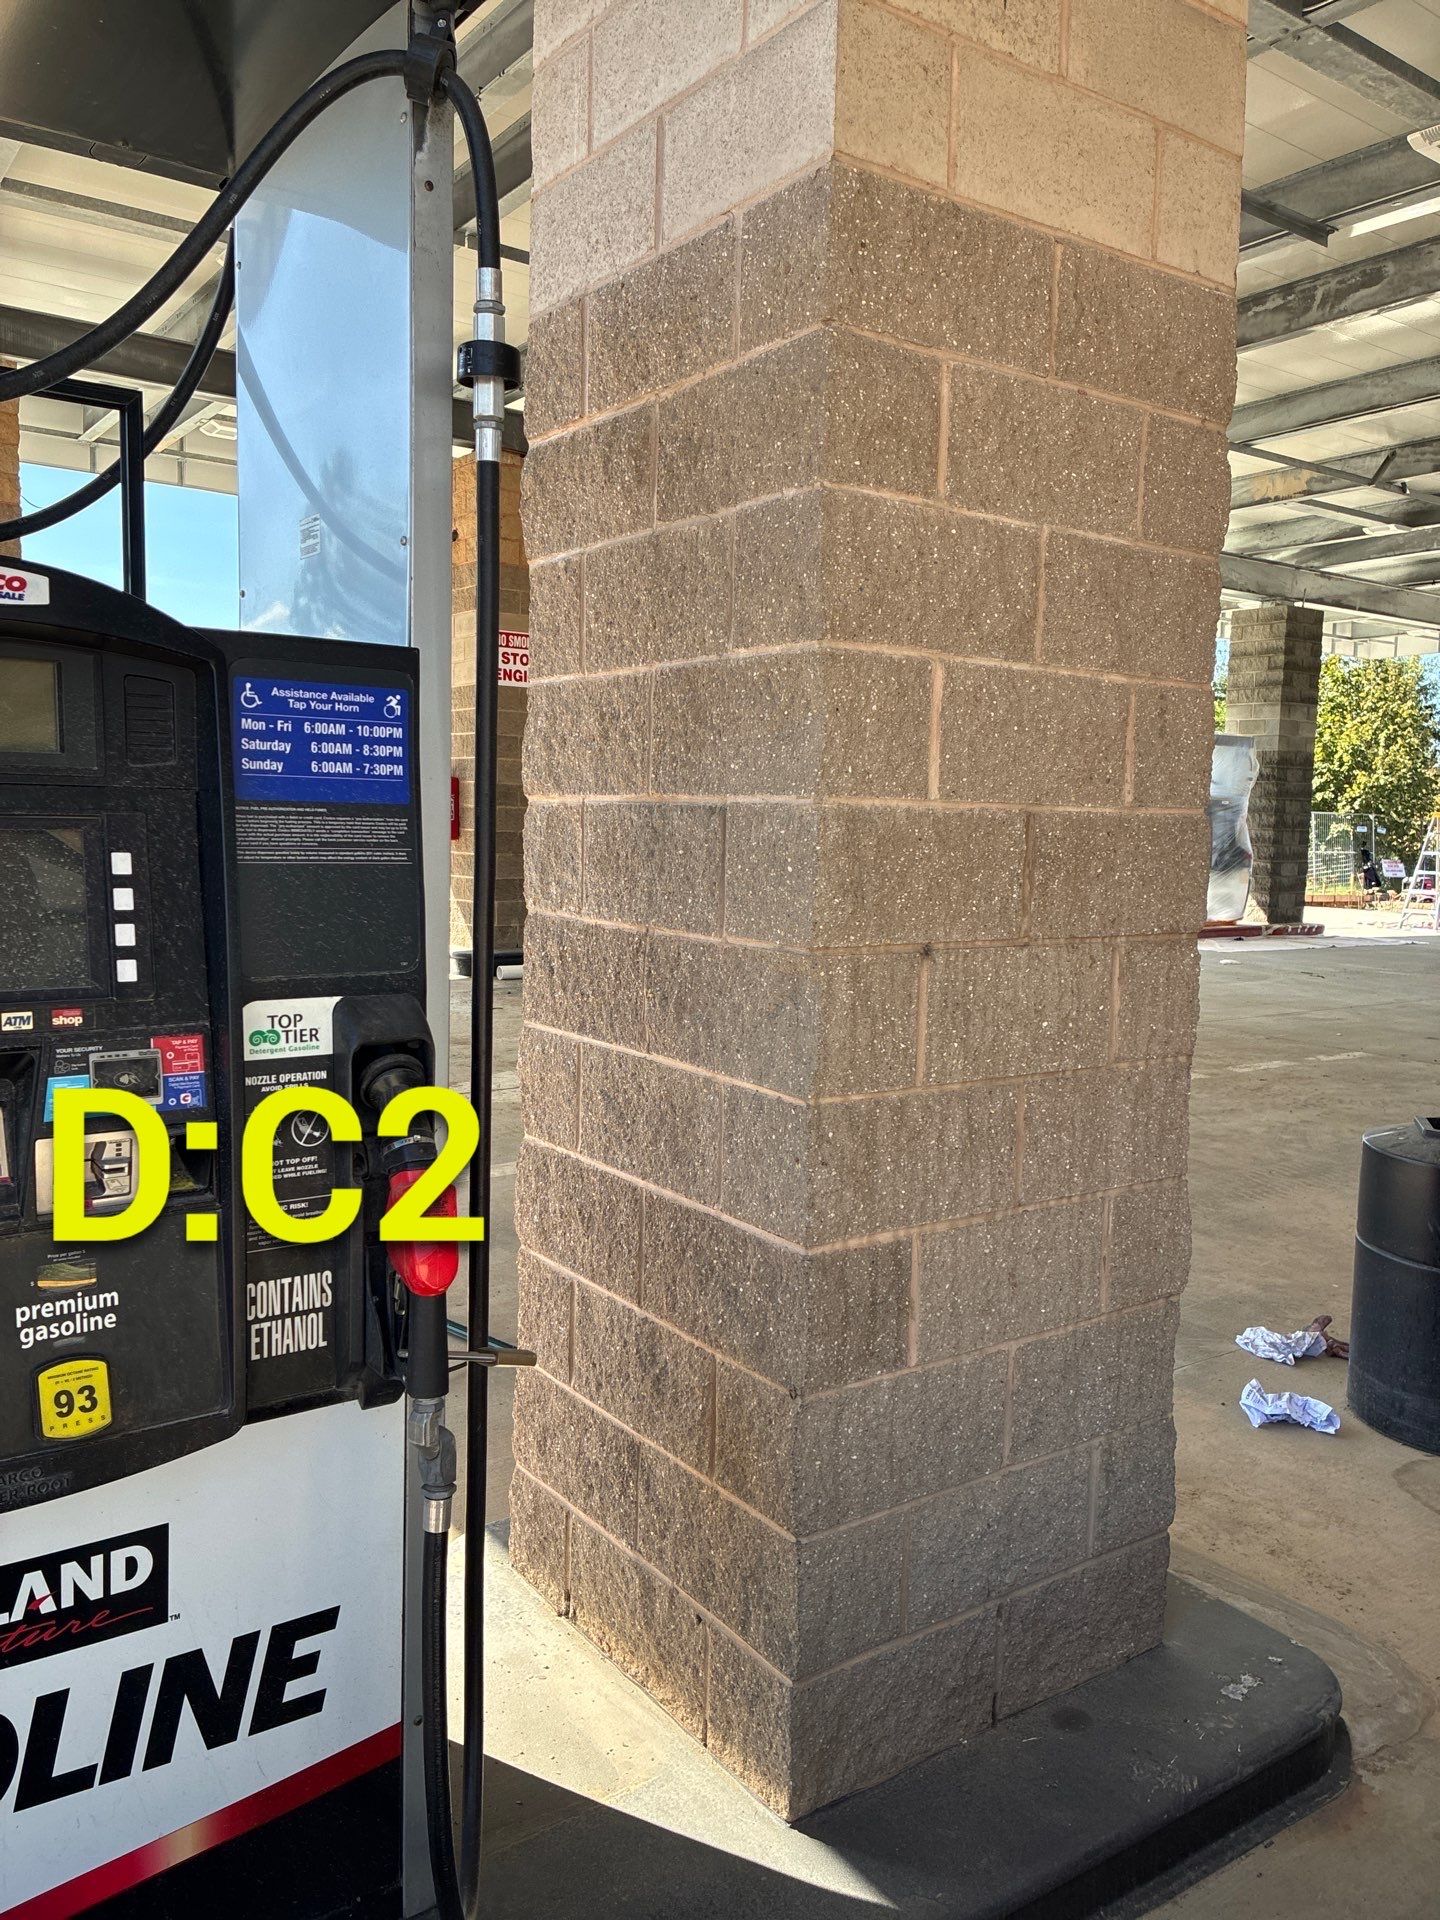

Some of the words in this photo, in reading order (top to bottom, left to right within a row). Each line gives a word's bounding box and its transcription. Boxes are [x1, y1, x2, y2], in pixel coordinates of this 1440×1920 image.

[271, 686, 328, 700] Assistance
[330, 691, 375, 703] Available
[288, 699, 307, 710] Tap
[309, 701, 332, 711] Your
[335, 703, 360, 713] Horn
[241, 718, 266, 730] Mon
[277, 720, 292, 732] Fri
[304, 722, 346, 736] 6:00AM
[357, 725, 403, 739] 10:00PM
[241, 738, 292, 753] Saturday
[311, 742, 352, 755] 6:00AM
[363, 744, 403, 758] 8:30PM
[241, 757, 284, 773] Sunday
[311, 761, 353, 774] 6:00AM
[363, 763, 404, 776] 7:30PM
[3, 1016, 31, 1027] ATM
[52, 1015, 83, 1027] shop
[267, 1014, 303, 1029] TOP
[282, 1028, 320, 1044] TIER
[249, 1047, 286, 1055] Detergent
[288, 1044, 320, 1052] Gasoline
[245, 1074, 277, 1086] NOZZLE
[279, 1070, 327, 1083] OPERATION
[290, 1202, 309, 1210] RISK!
[246, 1270, 332, 1321] CONTAINS
[16, 1291, 119, 1328] premium
[20, 1312, 117, 1349] gasoline
[251, 1311, 328, 1361] ETHANOL
[54, 1385, 98, 1418] 93
